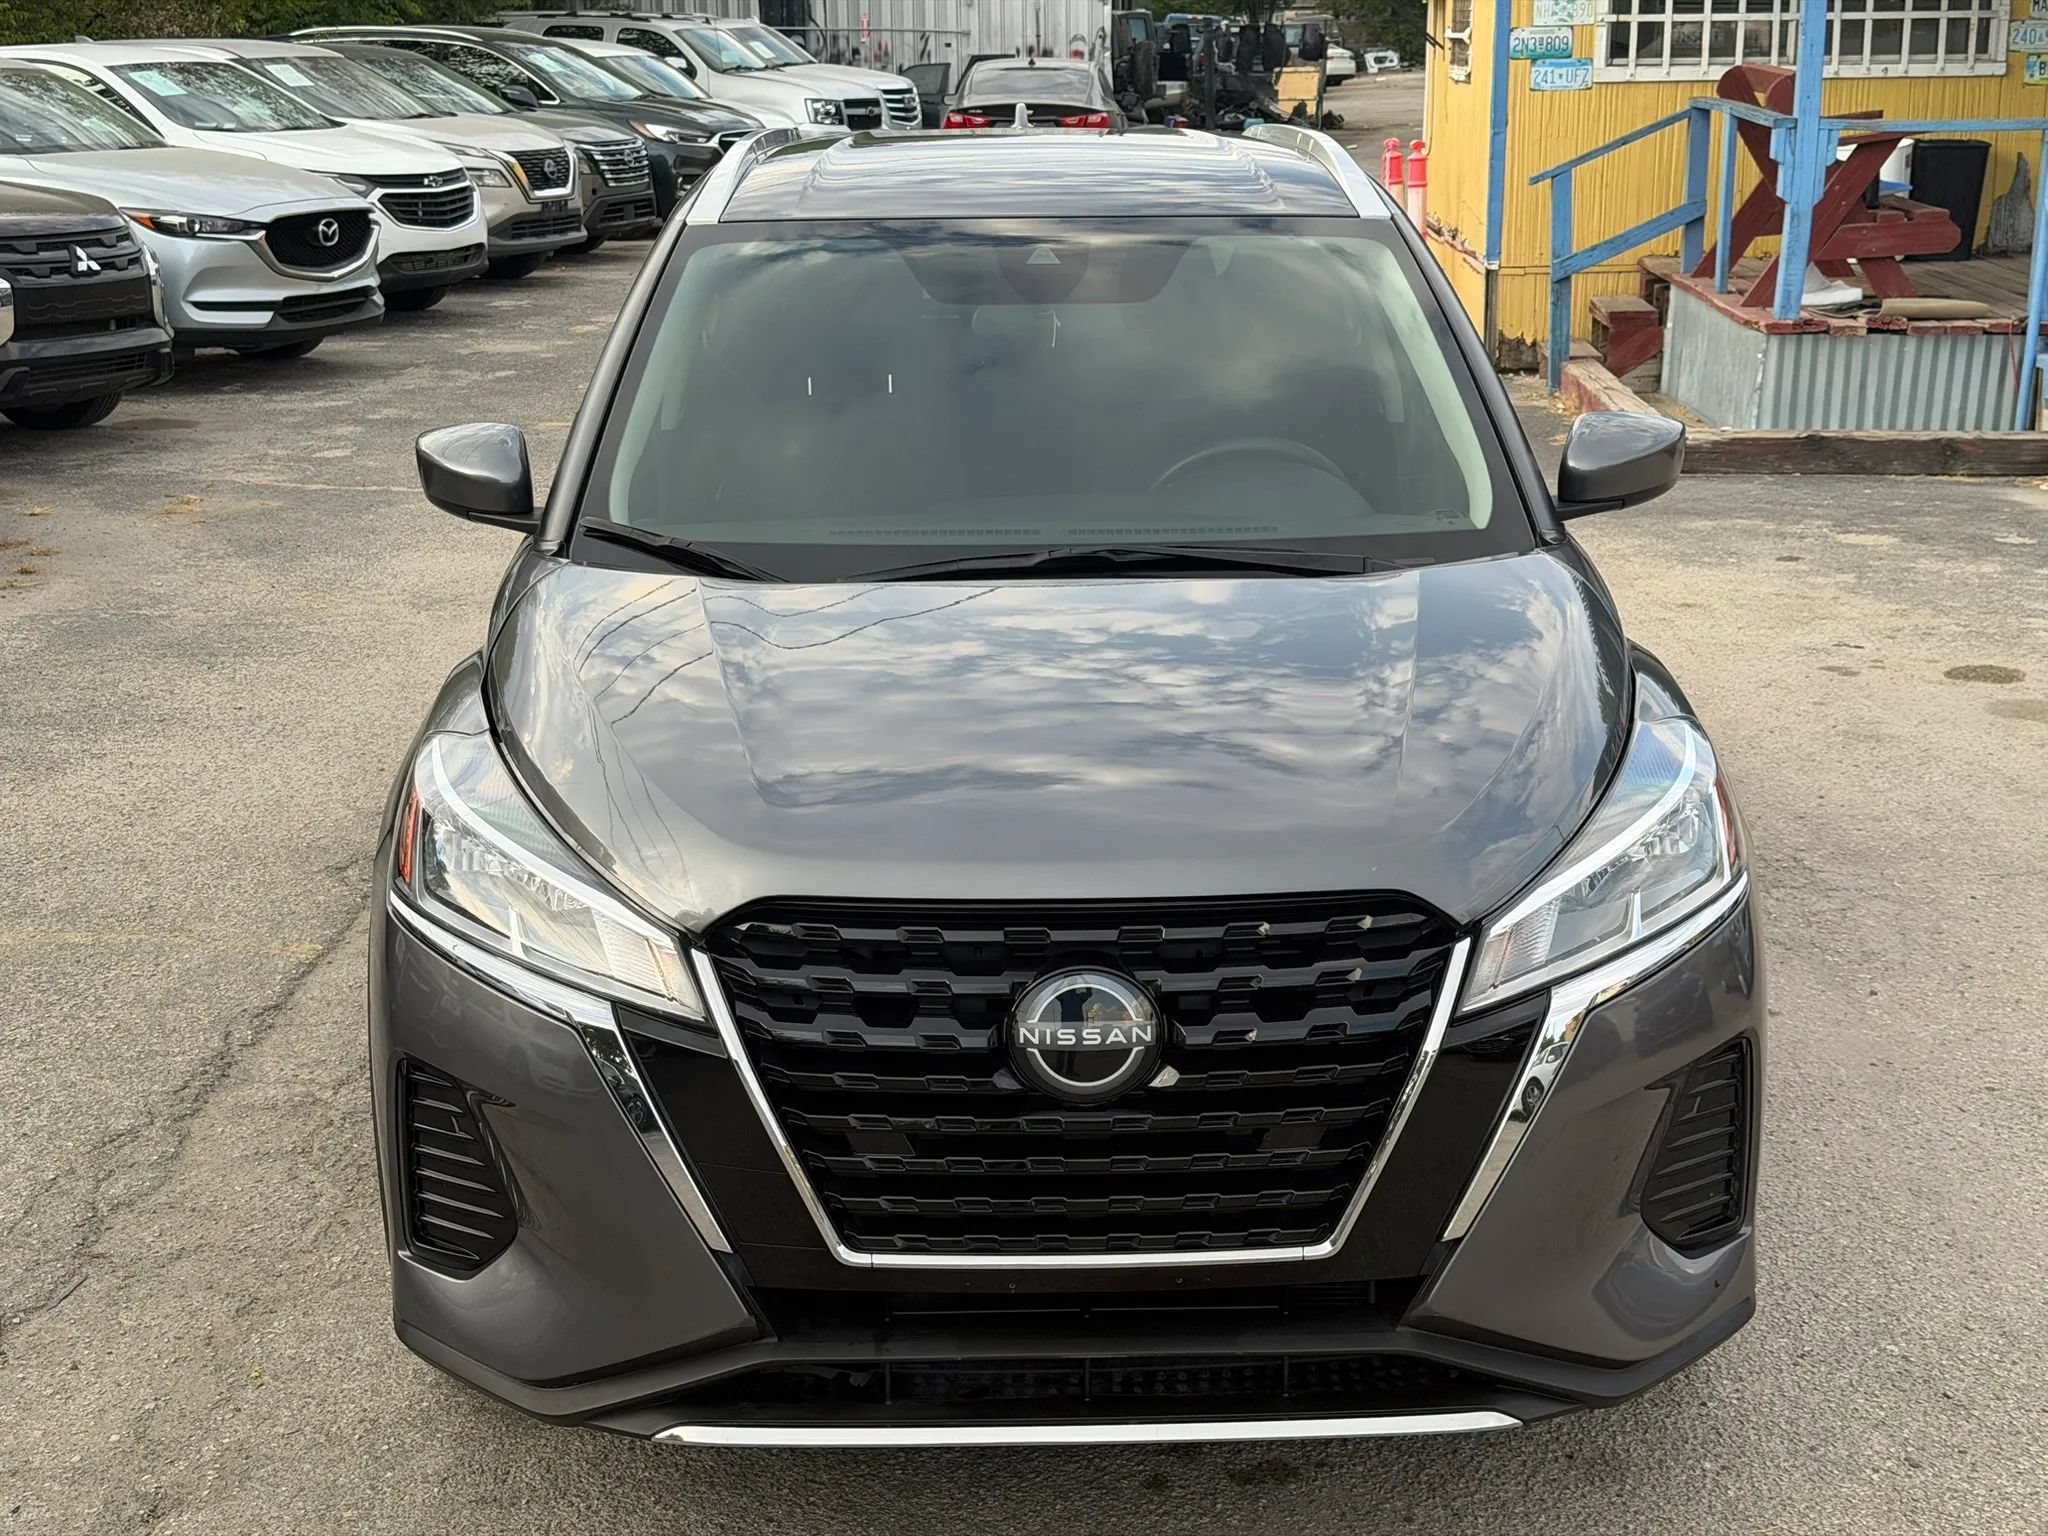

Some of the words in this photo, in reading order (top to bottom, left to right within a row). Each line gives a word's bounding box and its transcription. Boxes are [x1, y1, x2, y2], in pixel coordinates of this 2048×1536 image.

[1513, 36, 1537, 53] 2N3
[1545, 35, 1569, 52] 809
[1534, 69, 1556, 84] 241
[1019, 1025, 1152, 1046] NISSAN
